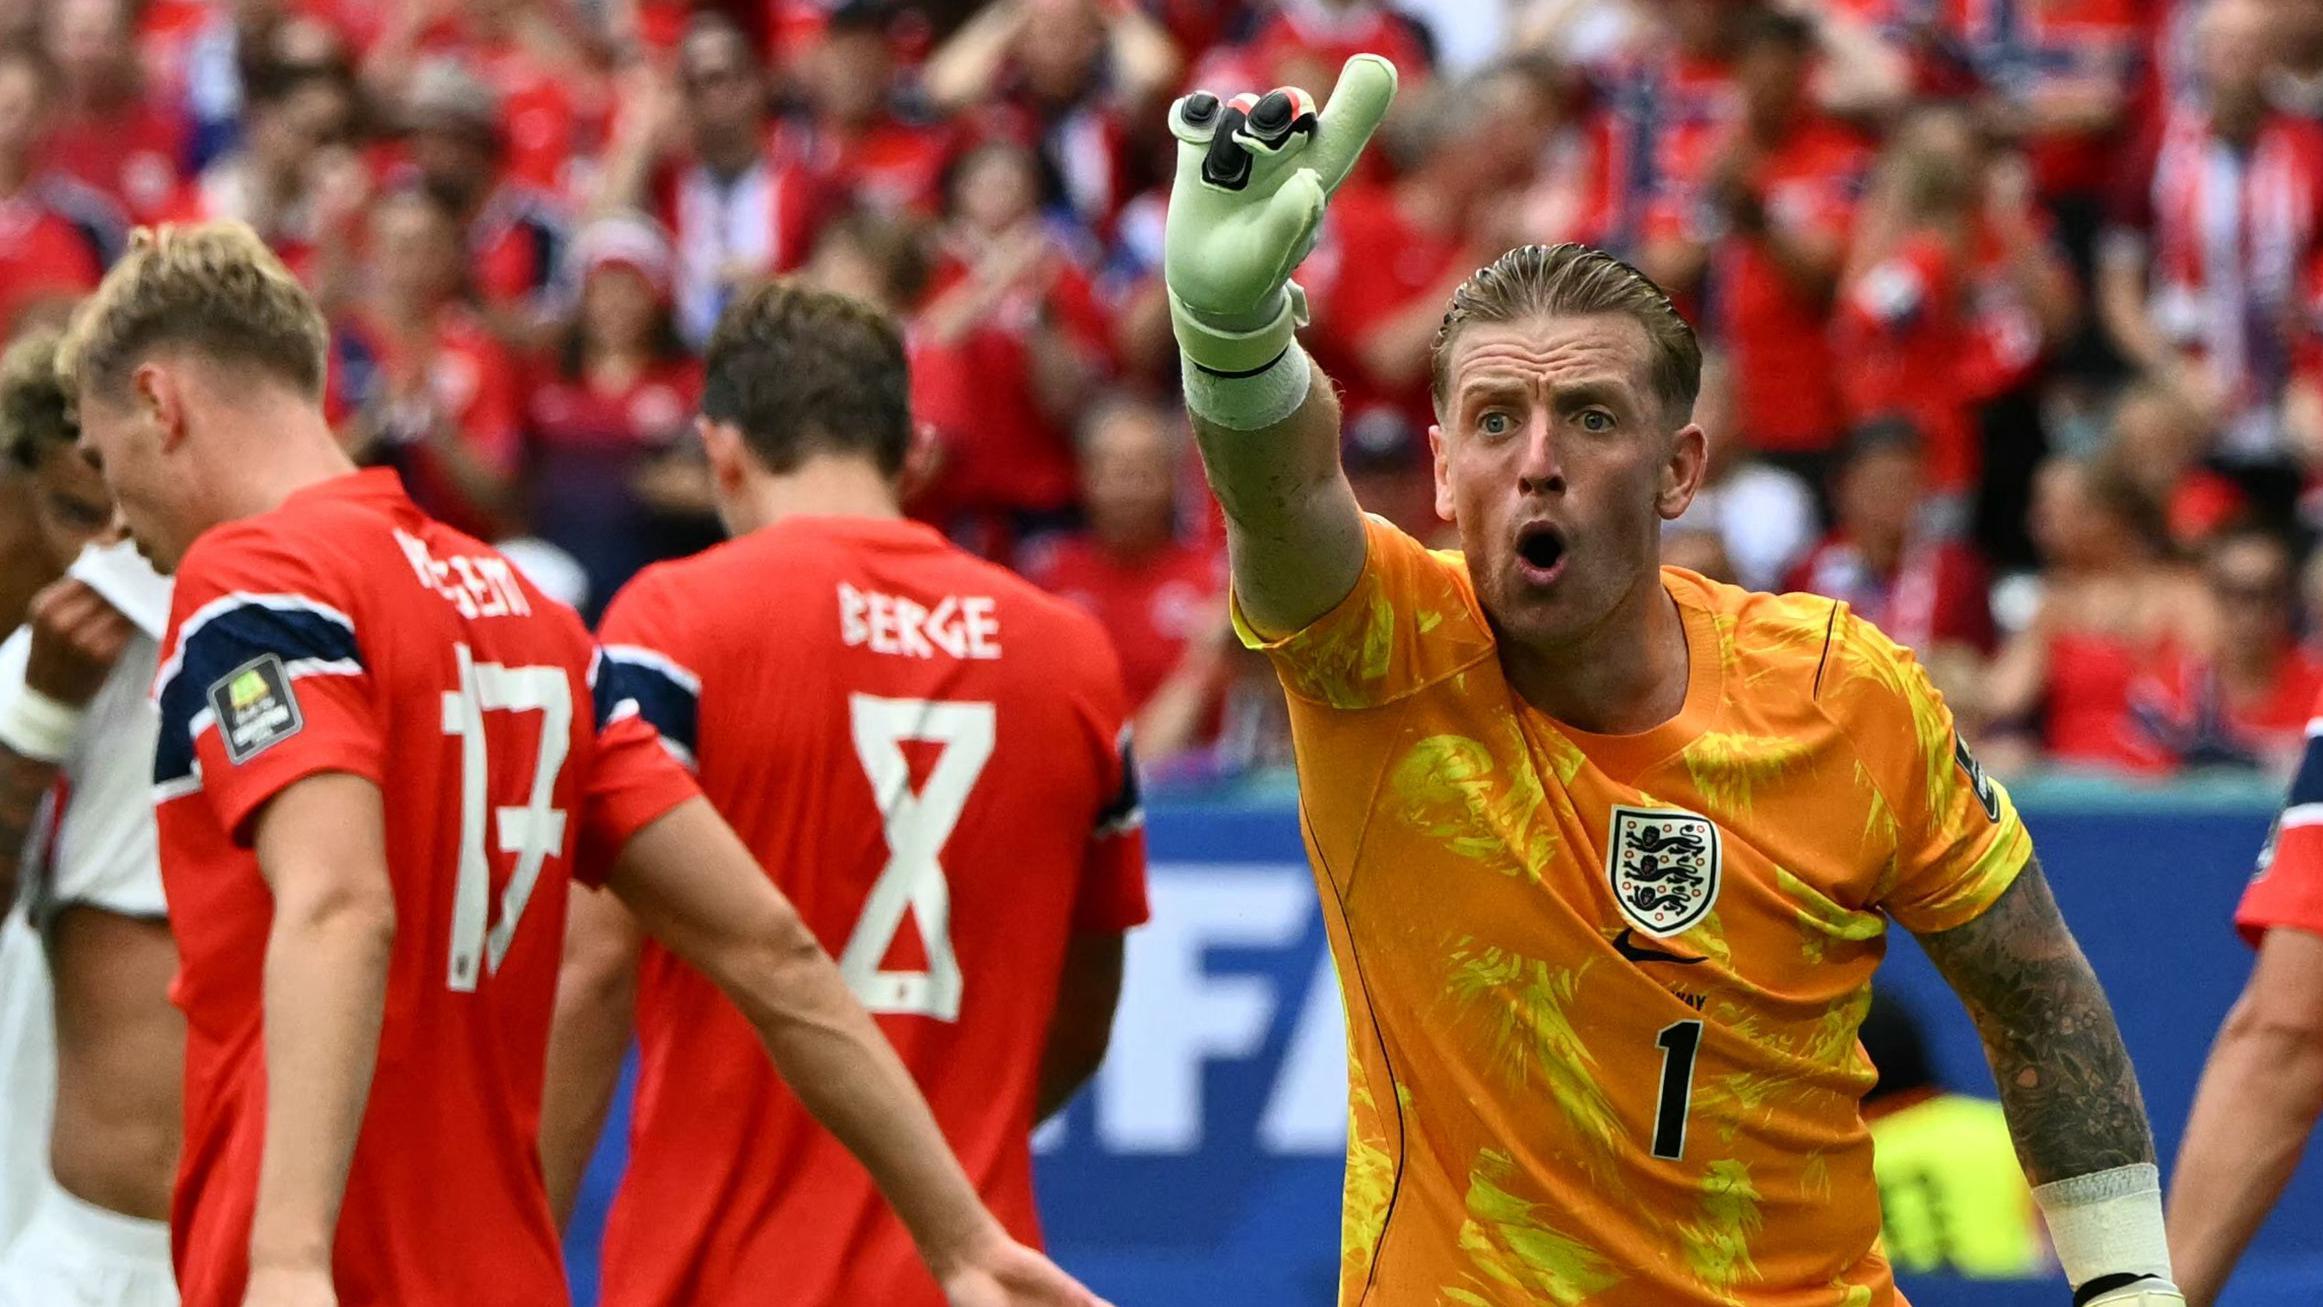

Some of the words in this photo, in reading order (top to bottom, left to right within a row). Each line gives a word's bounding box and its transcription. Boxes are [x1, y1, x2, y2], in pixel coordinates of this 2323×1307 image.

[837, 581, 1001, 660] BERGE
[442, 643, 572, 991] 17
[840, 691, 997, 1023] 8
[1650, 1019, 1704, 1162] 1
